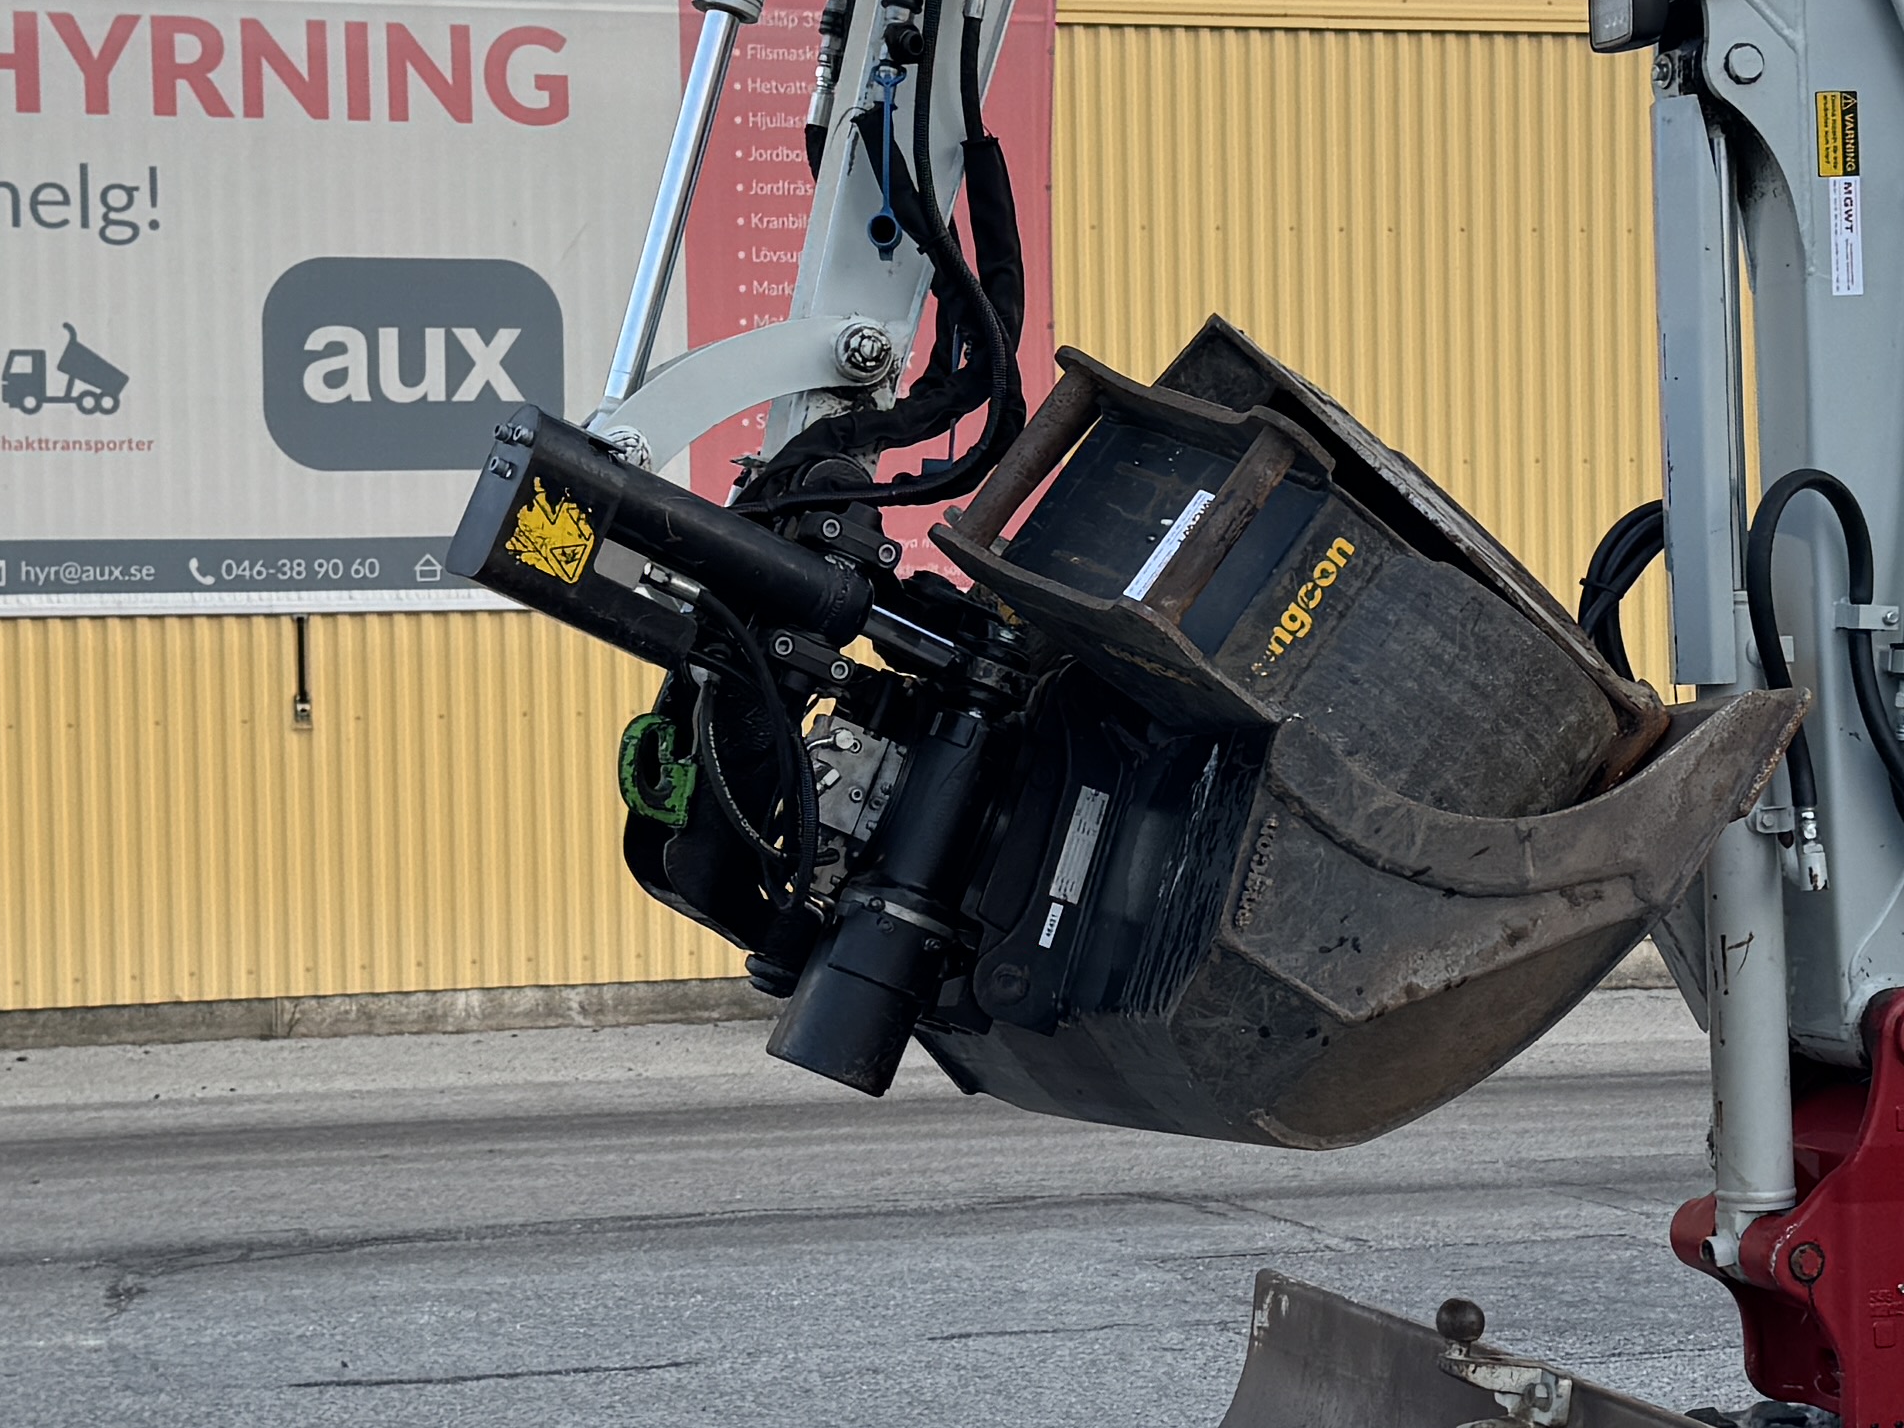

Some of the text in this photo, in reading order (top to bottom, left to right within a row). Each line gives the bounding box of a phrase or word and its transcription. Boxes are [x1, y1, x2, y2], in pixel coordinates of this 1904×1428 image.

[747, 44, 821, 61] Flismaski
[1844, 113, 1857, 172] VARNING
[1843, 181, 1855, 234] MGWT
[751, 212, 809, 229] Kranbil
[751, 245, 802, 263] Lövsu
[752, 280, 794, 297] Mark
[302, 323, 527, 403] aux
[19, 560, 156, 587] hyr@aux.se
[220, 557, 381, 582] 046-38 90 60
